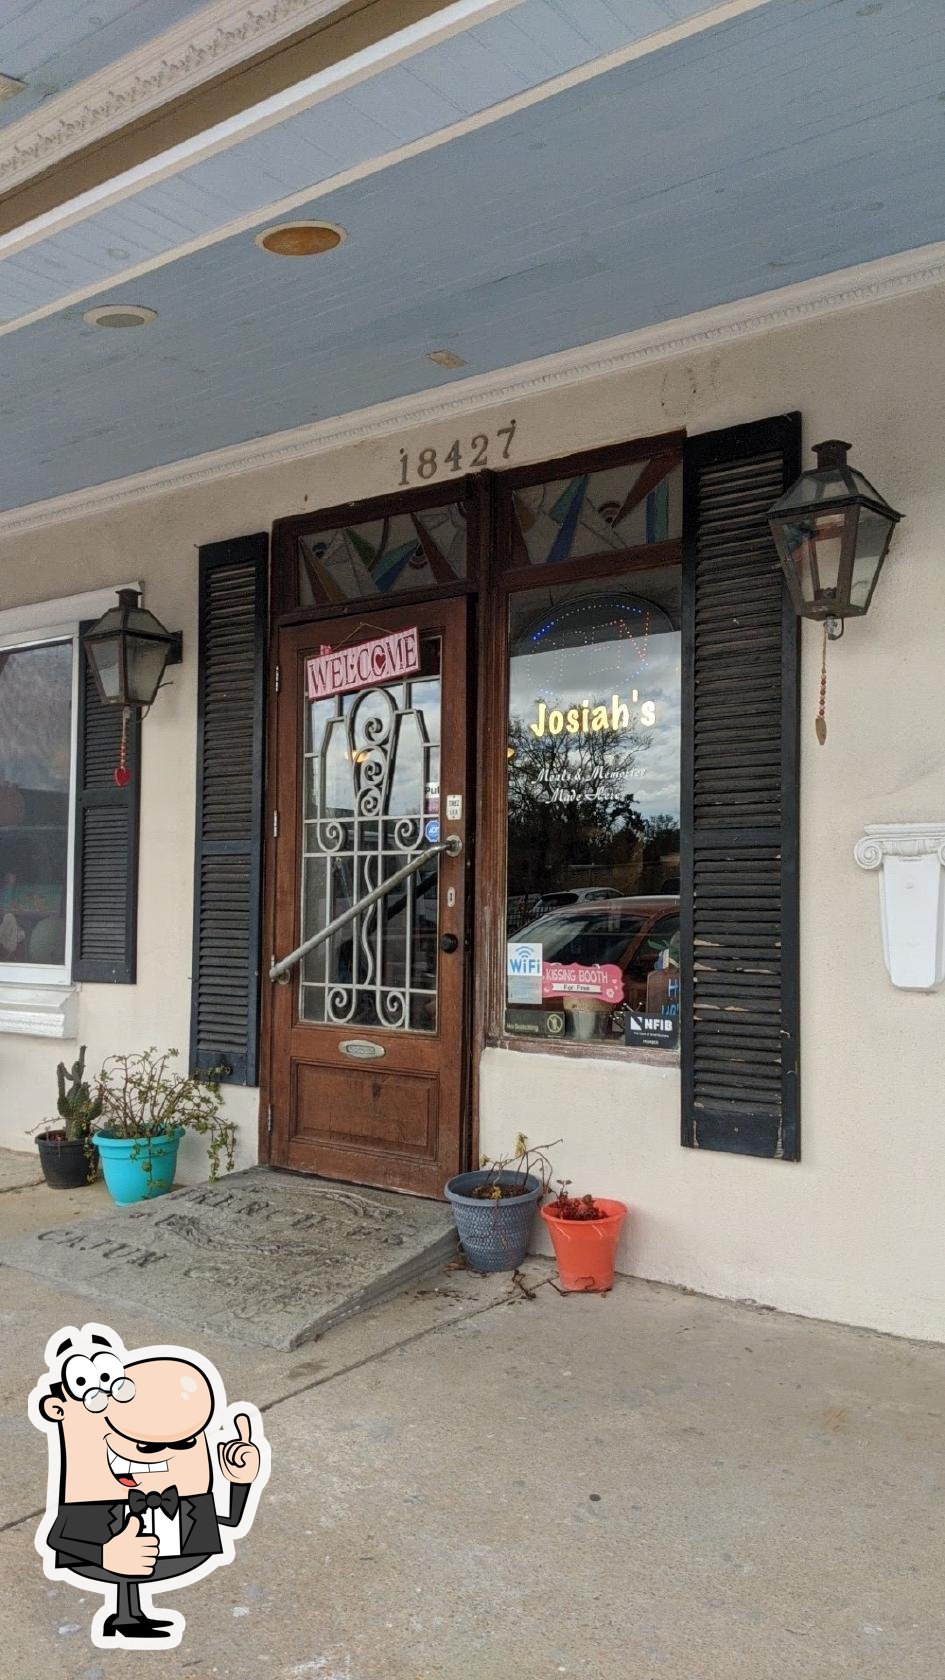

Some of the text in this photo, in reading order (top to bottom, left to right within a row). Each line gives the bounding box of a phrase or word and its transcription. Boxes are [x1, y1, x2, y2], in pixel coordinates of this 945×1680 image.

[398, 419, 516, 486] 18427
[309, 634, 417, 694] WELCOME
[530, 689, 656, 737] Josiah's
[510, 959, 540, 974] WiFi
[545, 969, 608, 984] KISSING BOOTH
[644, 1018, 673, 1032] NFIB
[38, 1229, 170, 1268] CAJUN
